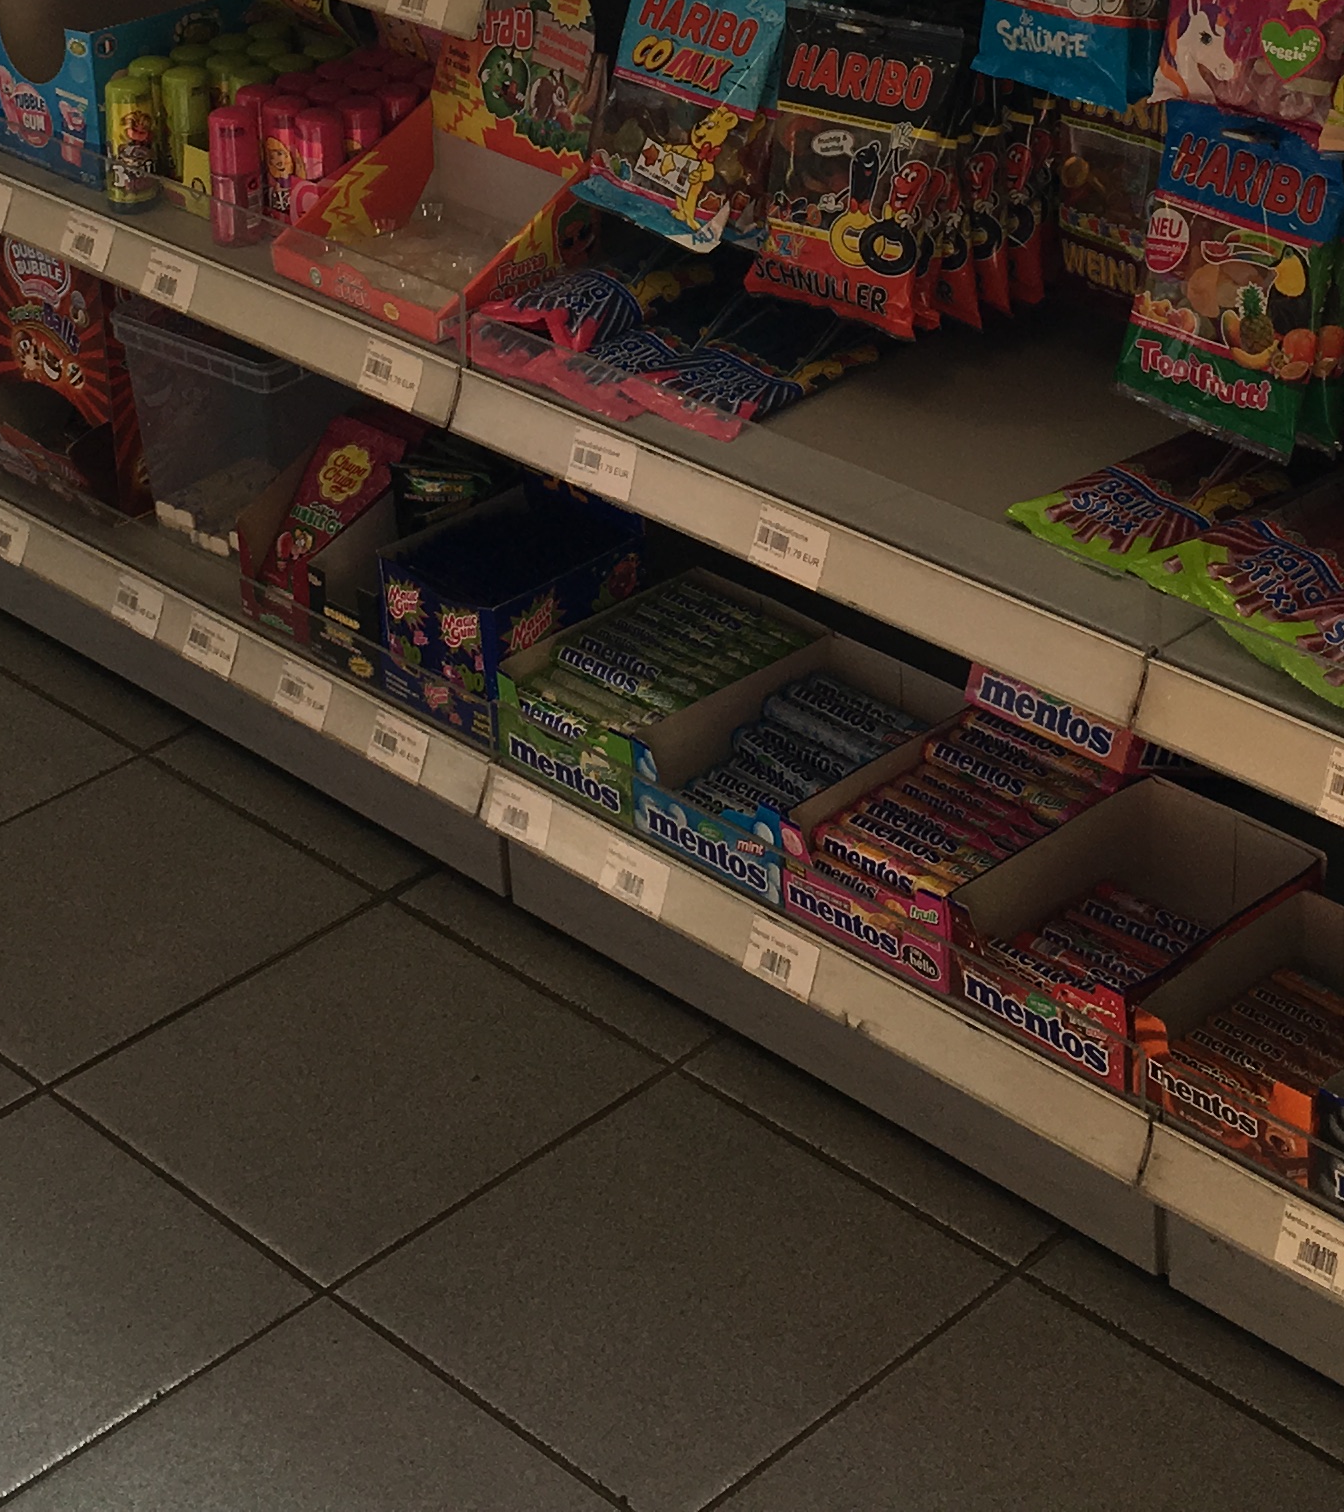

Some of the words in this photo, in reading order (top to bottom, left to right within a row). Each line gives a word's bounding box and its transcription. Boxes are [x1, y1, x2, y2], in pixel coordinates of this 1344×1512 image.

[787, 43, 934, 111] HARIBO
[1261, 39, 1307, 63] Veggie
[1171, 133, 1328, 226] HARIBO
[1149, 216, 1183, 239] NEU
[15, 258, 63, 285] BUBBLE
[755, 257, 888, 316] SCHNULLER
[1135, 339, 1272, 412] Tropifrutti
[980, 672, 1115, 757] mentos
[509, 734, 620, 814] mentos
[647, 805, 769, 891] mentos
[737, 837, 765, 857] mint
[787, 880, 901, 959] mentos
[910, 906, 938, 926] fruit
[909, 953, 937, 978] hello
[965, 971, 1109, 1076] mentos
[1149, 1058, 1258, 1138] mentos
